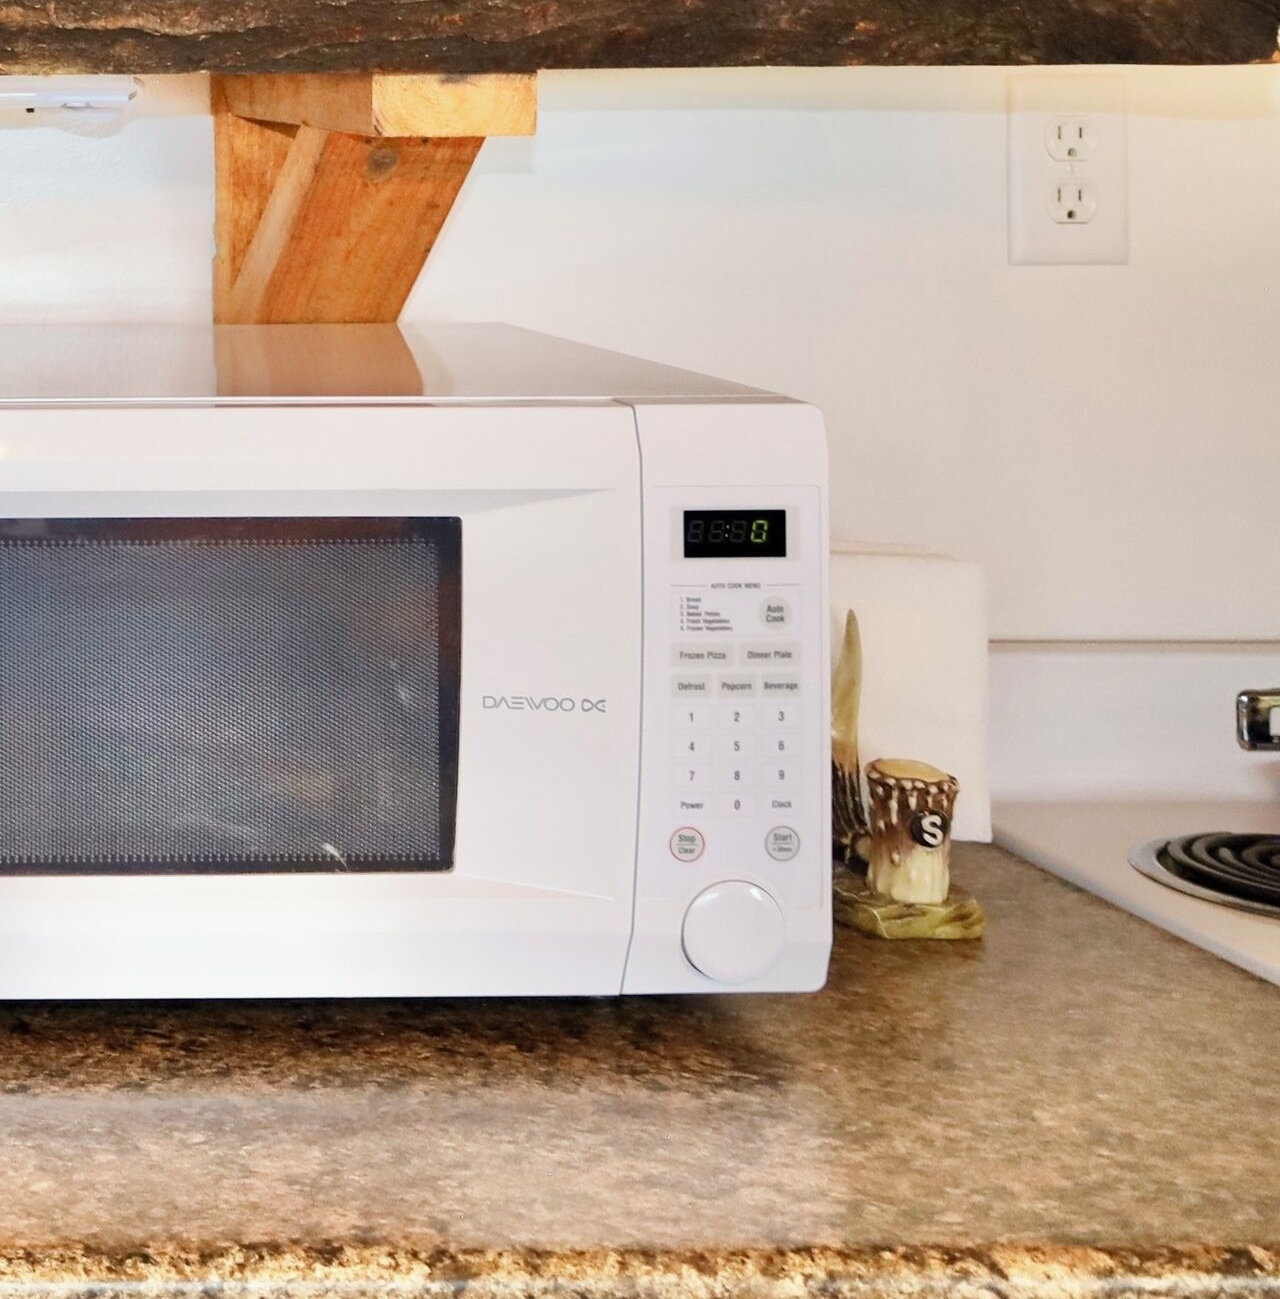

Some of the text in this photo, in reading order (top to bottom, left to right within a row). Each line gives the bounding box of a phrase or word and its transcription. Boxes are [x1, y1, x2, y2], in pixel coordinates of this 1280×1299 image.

[766, 614, 785, 623] Cook
[679, 651, 726, 660] Frozen Pizza
[747, 650, 792, 659] Dinner Plate
[678, 682, 705, 691] Defrost
[721, 682, 752, 691] Popcorn
[764, 681, 798, 690] Beverage
[482, 695, 575, 712] DAEWOO
[689, 712, 694, 722] 1
[734, 711, 740, 722] 2
[778, 711, 784, 721] 3
[689, 741, 695, 751] 4
[734, 741, 740, 751] 5
[778, 740, 784, 750] 6
[689, 770, 695, 780] 7
[734, 770, 740, 780] 8
[778, 769, 785, 780] 9
[680, 801, 703, 809] Power
[734, 799, 740, 810] 0
[772, 800, 792, 808] Clock
[920, 813, 944, 844] S
[678, 834, 696, 843] Stop
[773, 833, 792, 842] Start
